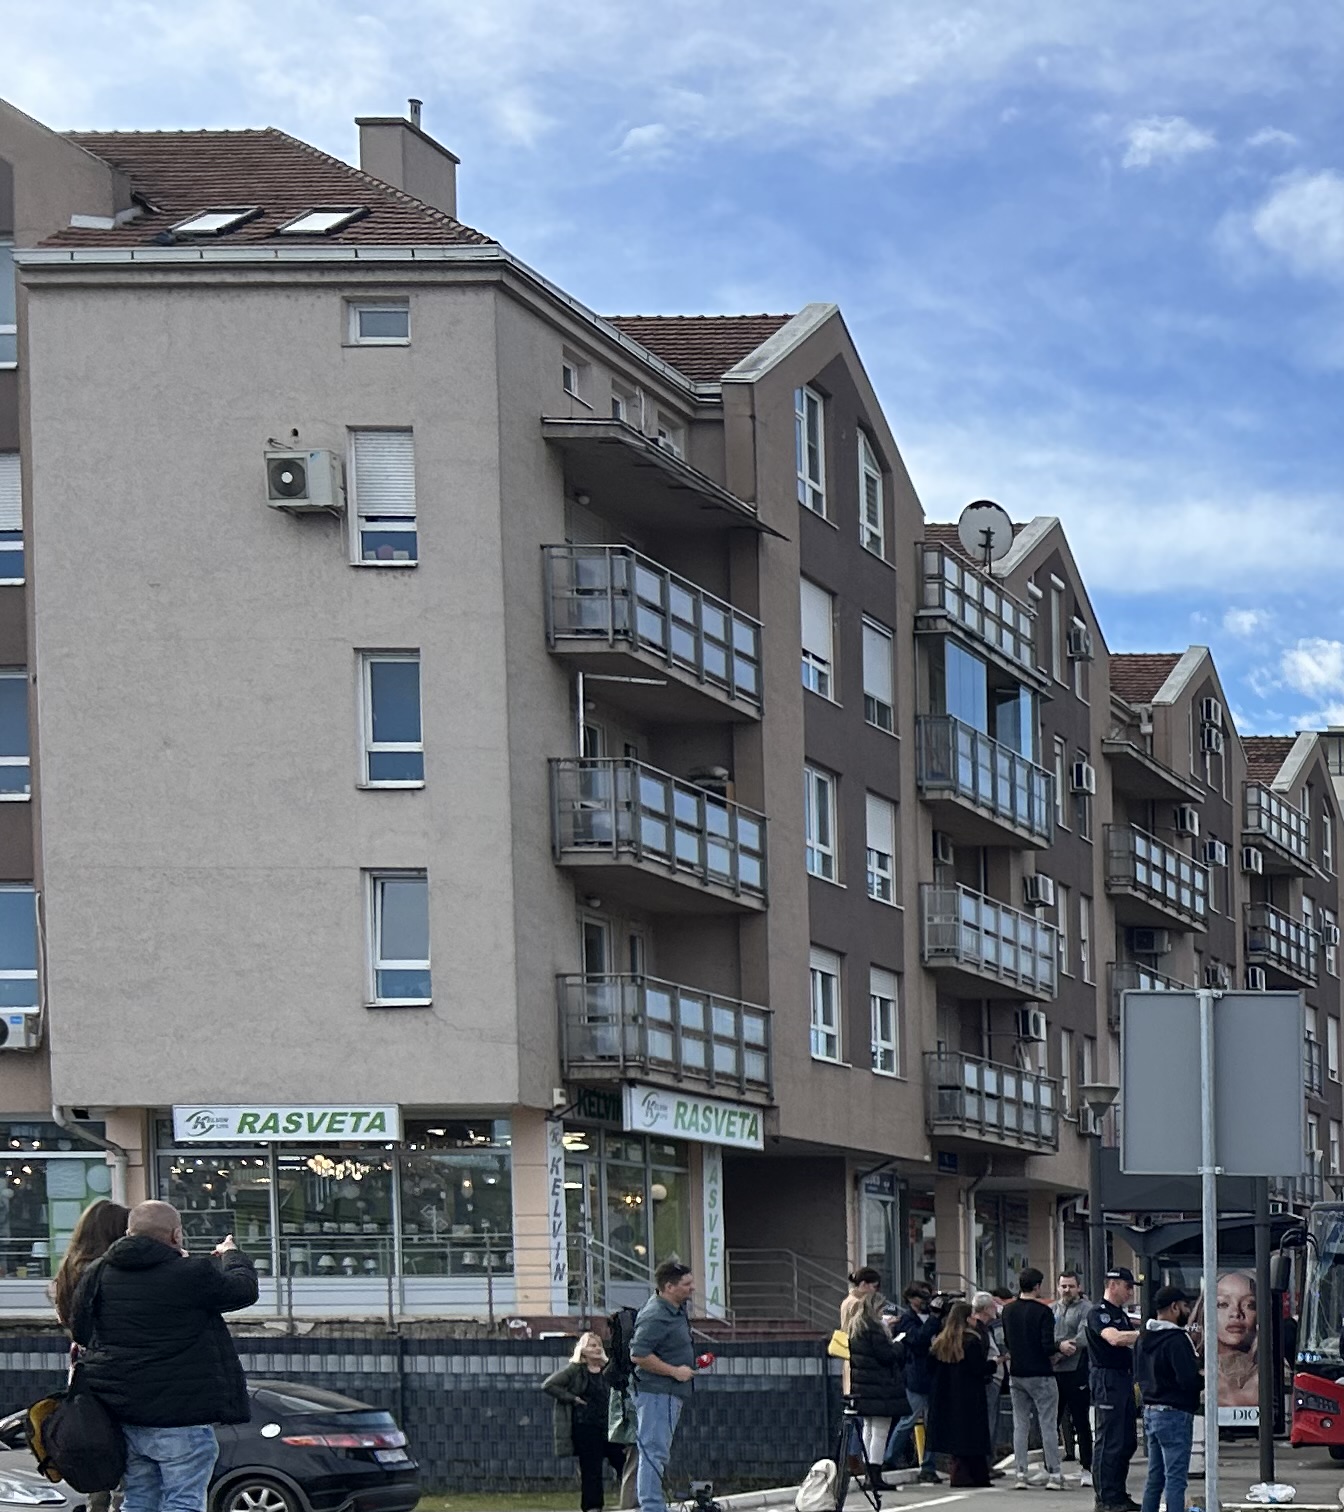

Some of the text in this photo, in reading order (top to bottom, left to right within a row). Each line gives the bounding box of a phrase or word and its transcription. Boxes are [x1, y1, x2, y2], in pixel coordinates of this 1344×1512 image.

[237, 1111, 386, 1134] RASVETA
[673, 1100, 759, 1141] RASVETA
[550, 1157, 566, 1282] KELVIN
[1233, 1409, 1260, 1420] DIO
